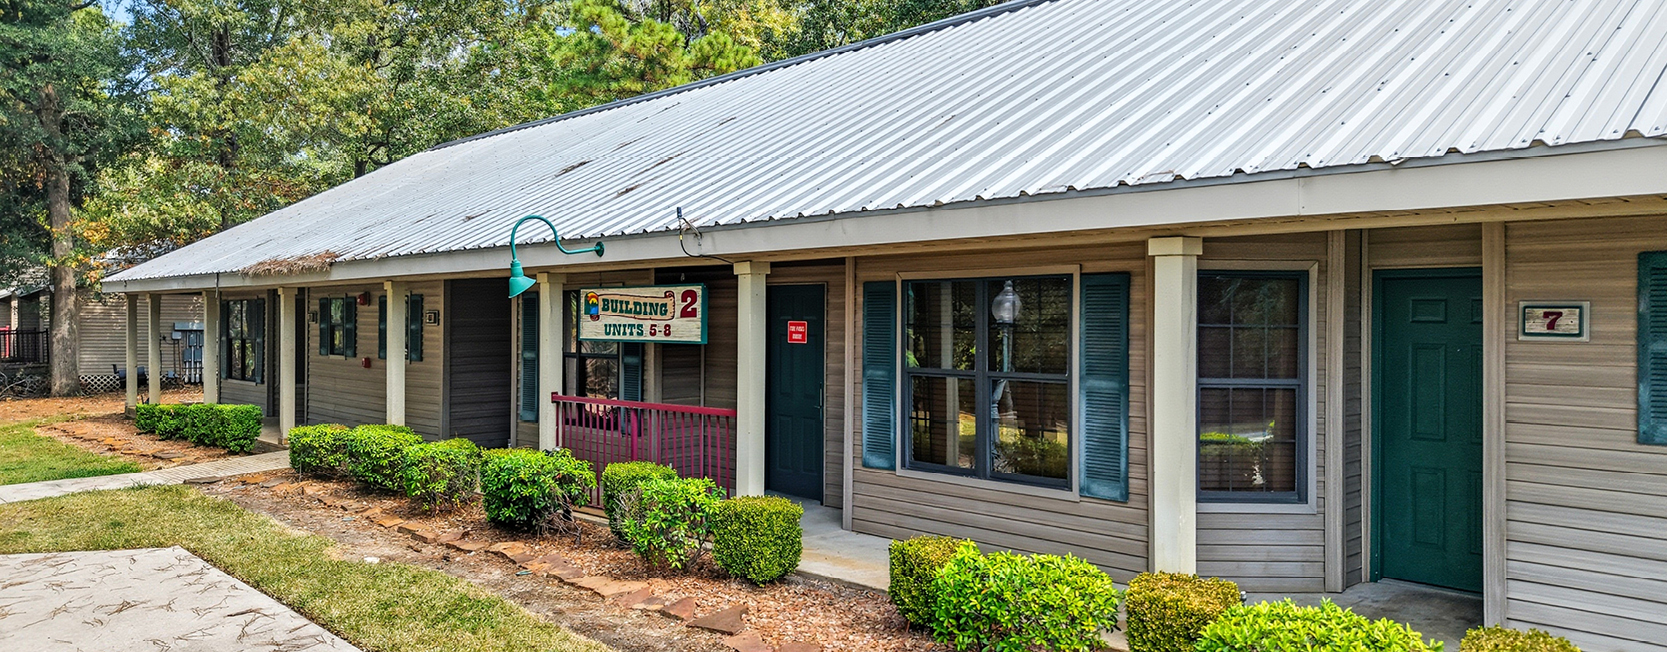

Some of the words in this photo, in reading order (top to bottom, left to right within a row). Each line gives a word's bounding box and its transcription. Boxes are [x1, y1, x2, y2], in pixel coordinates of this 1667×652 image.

[601, 298, 668, 316] BUILDING
[680, 289, 698, 318] 2
[604, 324, 644, 336] UNITS
[649, 324, 672, 336] 5-8
[1543, 311, 1563, 331] 7
